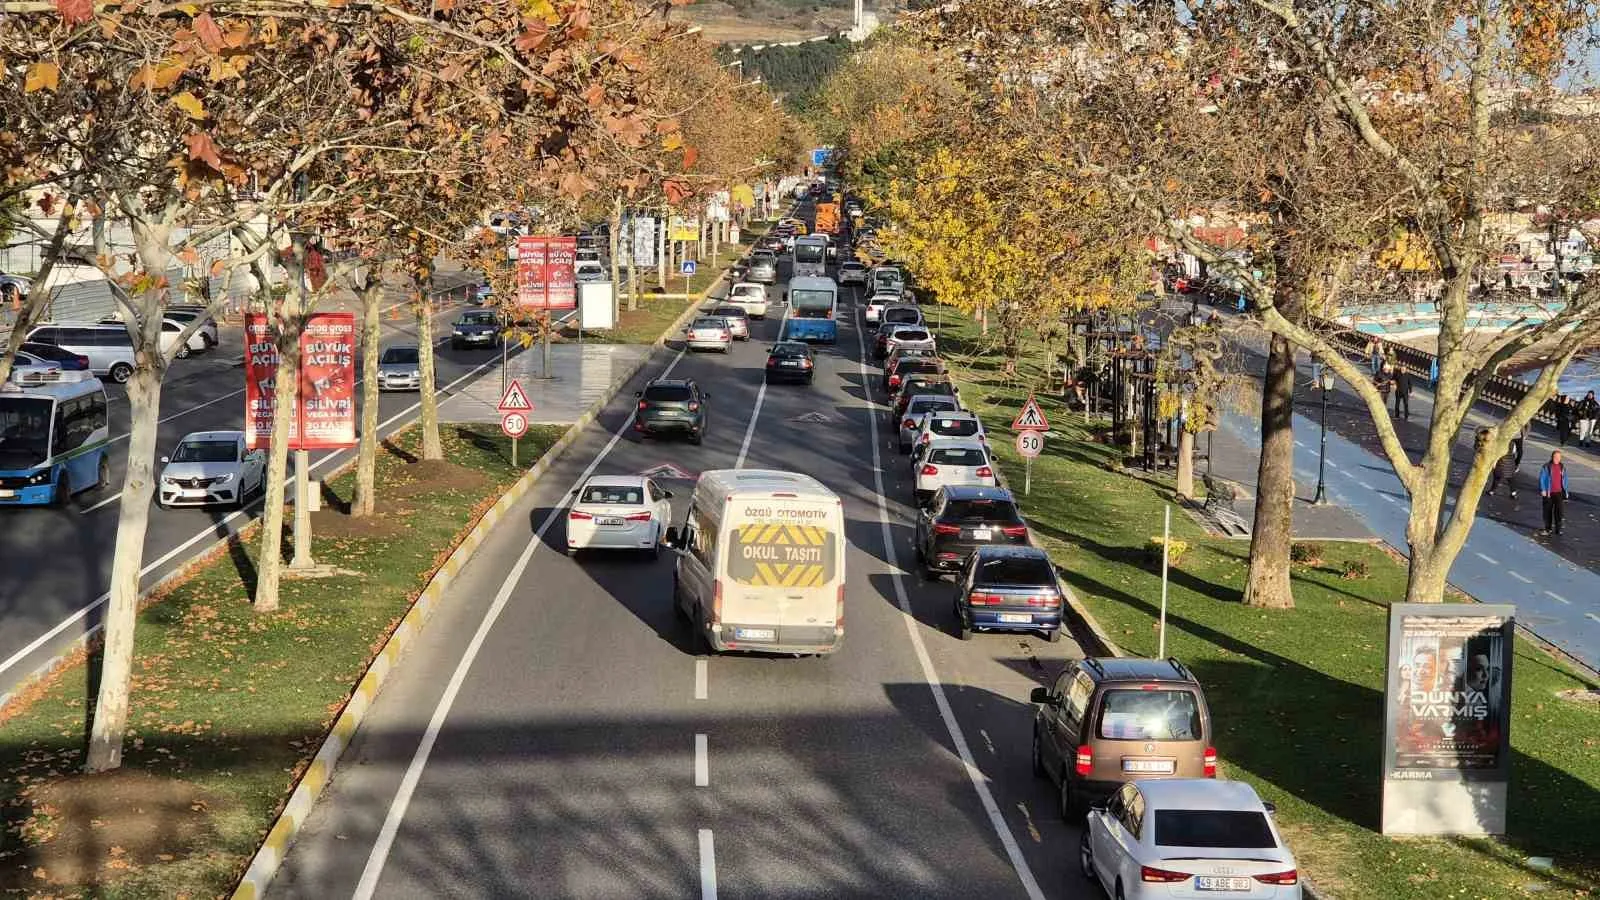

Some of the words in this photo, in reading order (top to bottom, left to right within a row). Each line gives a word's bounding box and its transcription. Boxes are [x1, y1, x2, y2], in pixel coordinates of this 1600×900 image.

[304, 340, 352, 354] BÜYÜK
[306, 354, 352, 368] AÇILIŞ
[305, 396, 351, 410] SİLİVRİ
[508, 418, 522, 430] 50
[1022, 436, 1039, 450] 50
[743, 544, 779, 560] OKUL
[785, 546, 820, 563] TAŞITI
[1411, 689, 1487, 704] DÜNYA
[1411, 704, 1488, 720] VARMIŞ
[1394, 770, 1432, 779] KARMA
